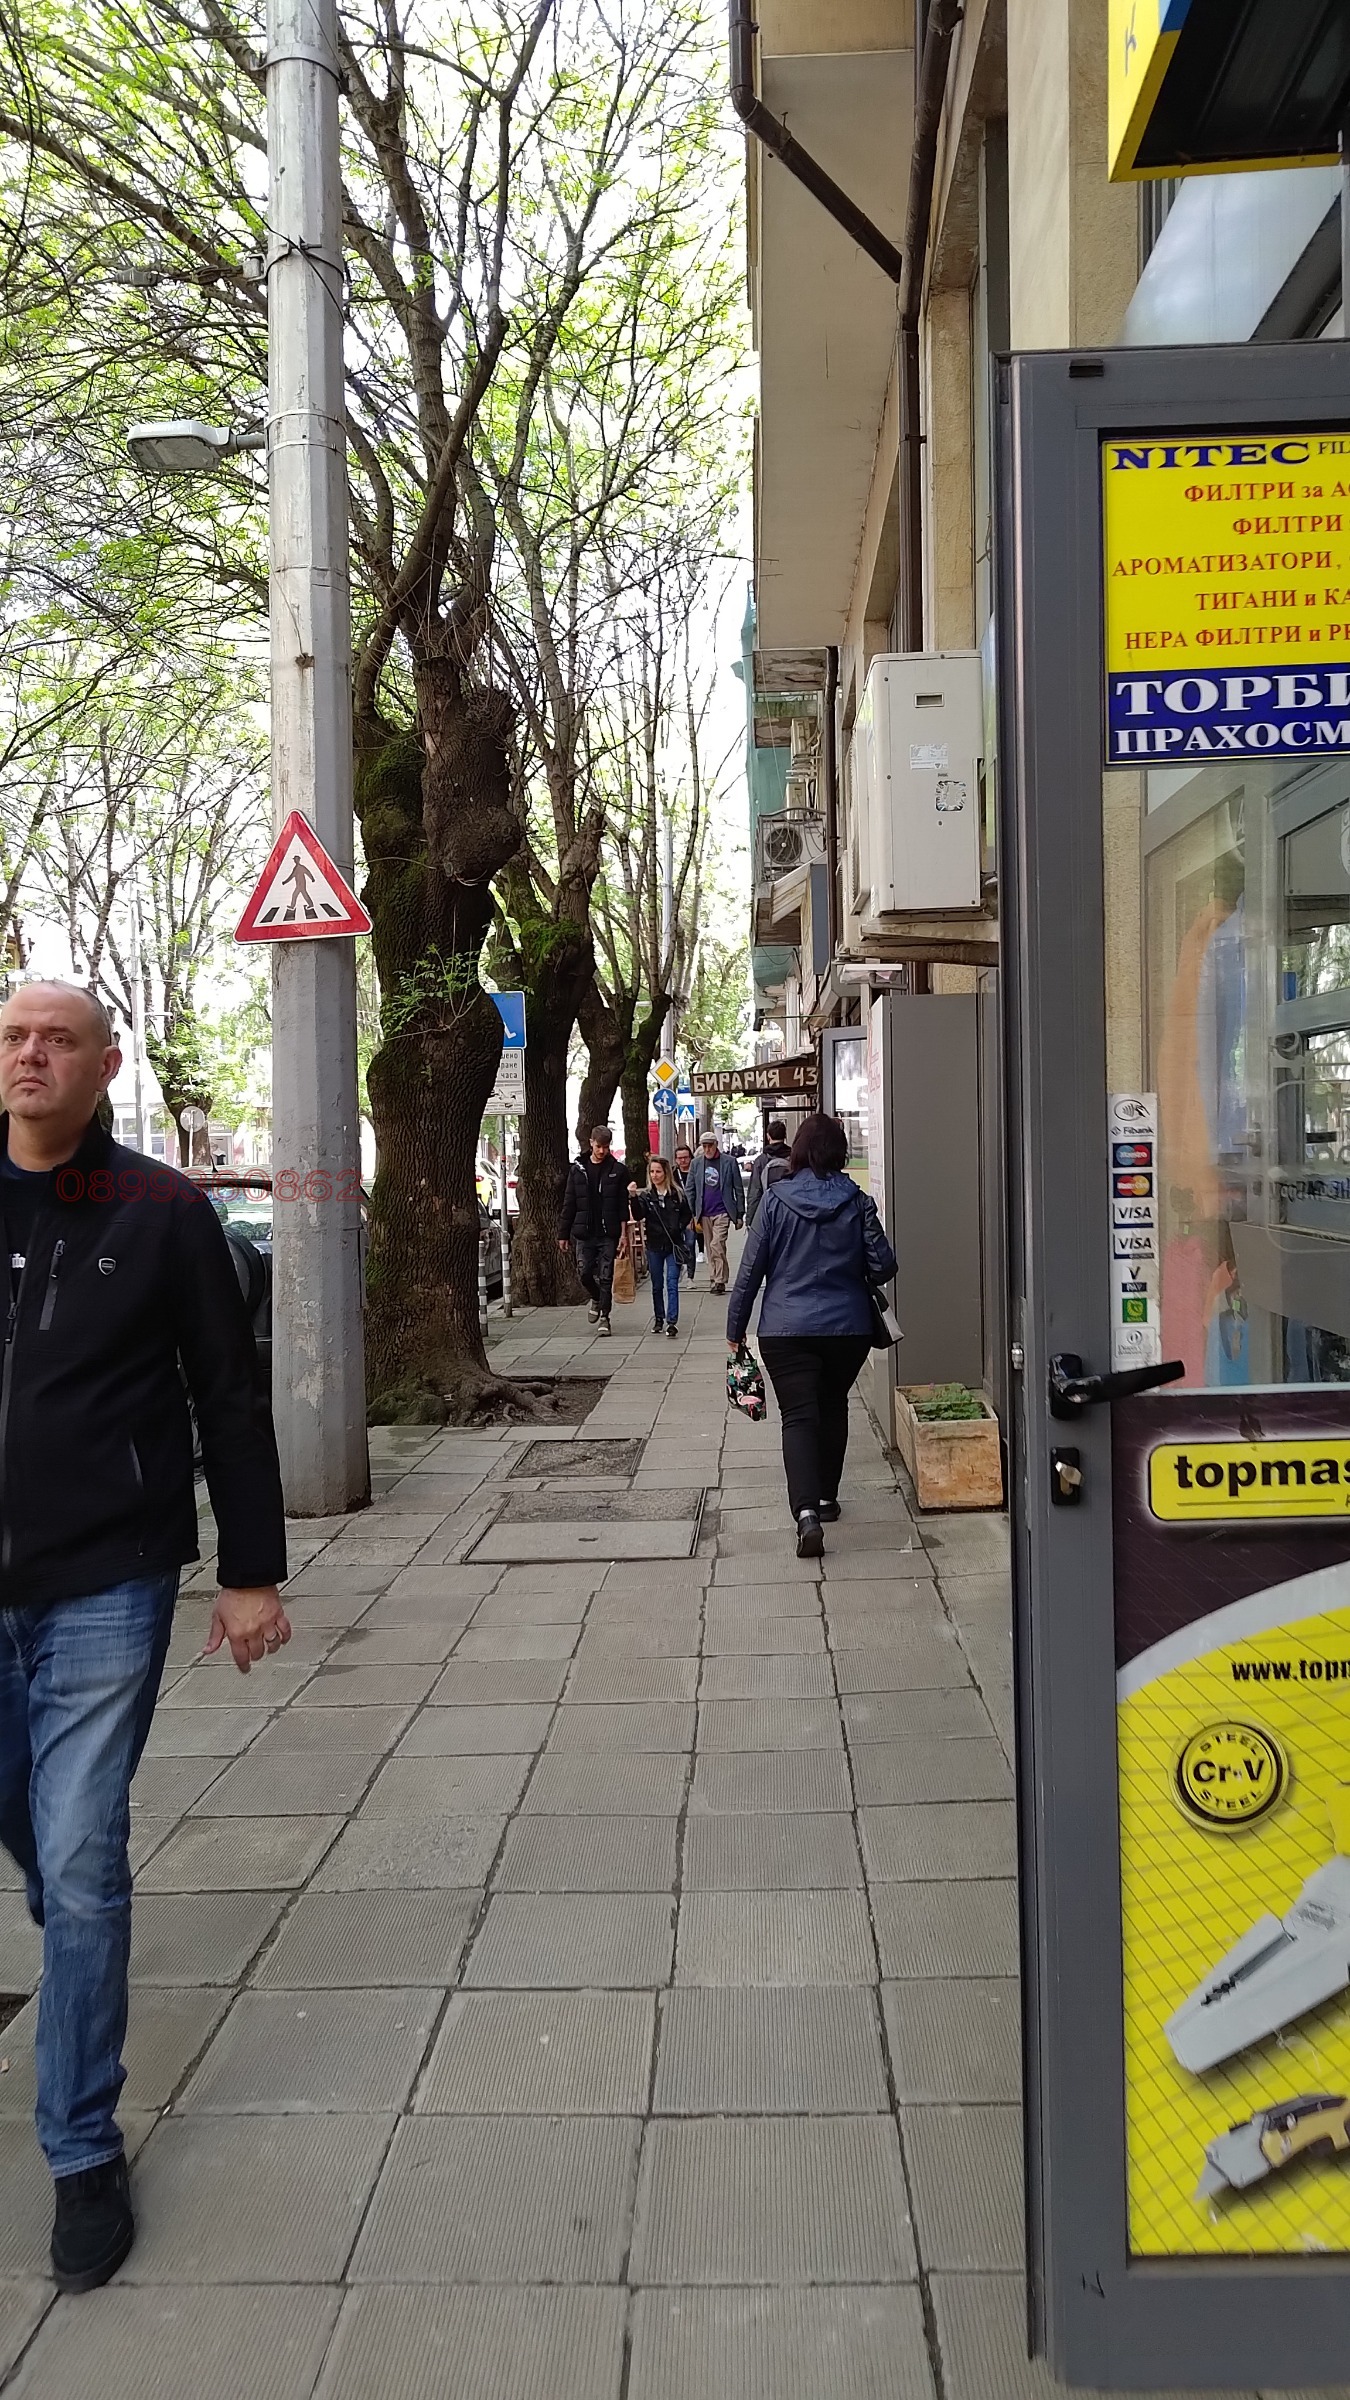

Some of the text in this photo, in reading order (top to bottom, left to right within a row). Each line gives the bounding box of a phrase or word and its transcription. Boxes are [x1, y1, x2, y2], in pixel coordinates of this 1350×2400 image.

[1110, 442, 1310, 470] NITEC
[1184, 481, 1350, 502] ФИЛТРИ за А
[1232, 514, 1343, 535] ФИЛТРИ
[1112, 551, 1342, 577] АРОМАТИЗАТОРИ,
[1195, 589, 1297, 611] ТИГАНИ
[1304, 594, 1316, 606] и
[1125, 631, 1188, 650] НЕРА
[1195, 625, 1301, 647] ФИЛТРИ
[1308, 629, 1321, 642] и
[1116, 673, 1350, 716] ТОРБИ
[1114, 720, 1350, 754] ПРАХОСМ
[692, 1065, 818, 1093] БИРАРИЯ 43
[1117, 1206, 1152, 1219] VISA
[1118, 1237, 1152, 1249] VISA
[1128, 1266, 1141, 1280] V
[1200, 1732, 1260, 1756] STEEL
[1200, 1789, 1263, 1812] STEEL
